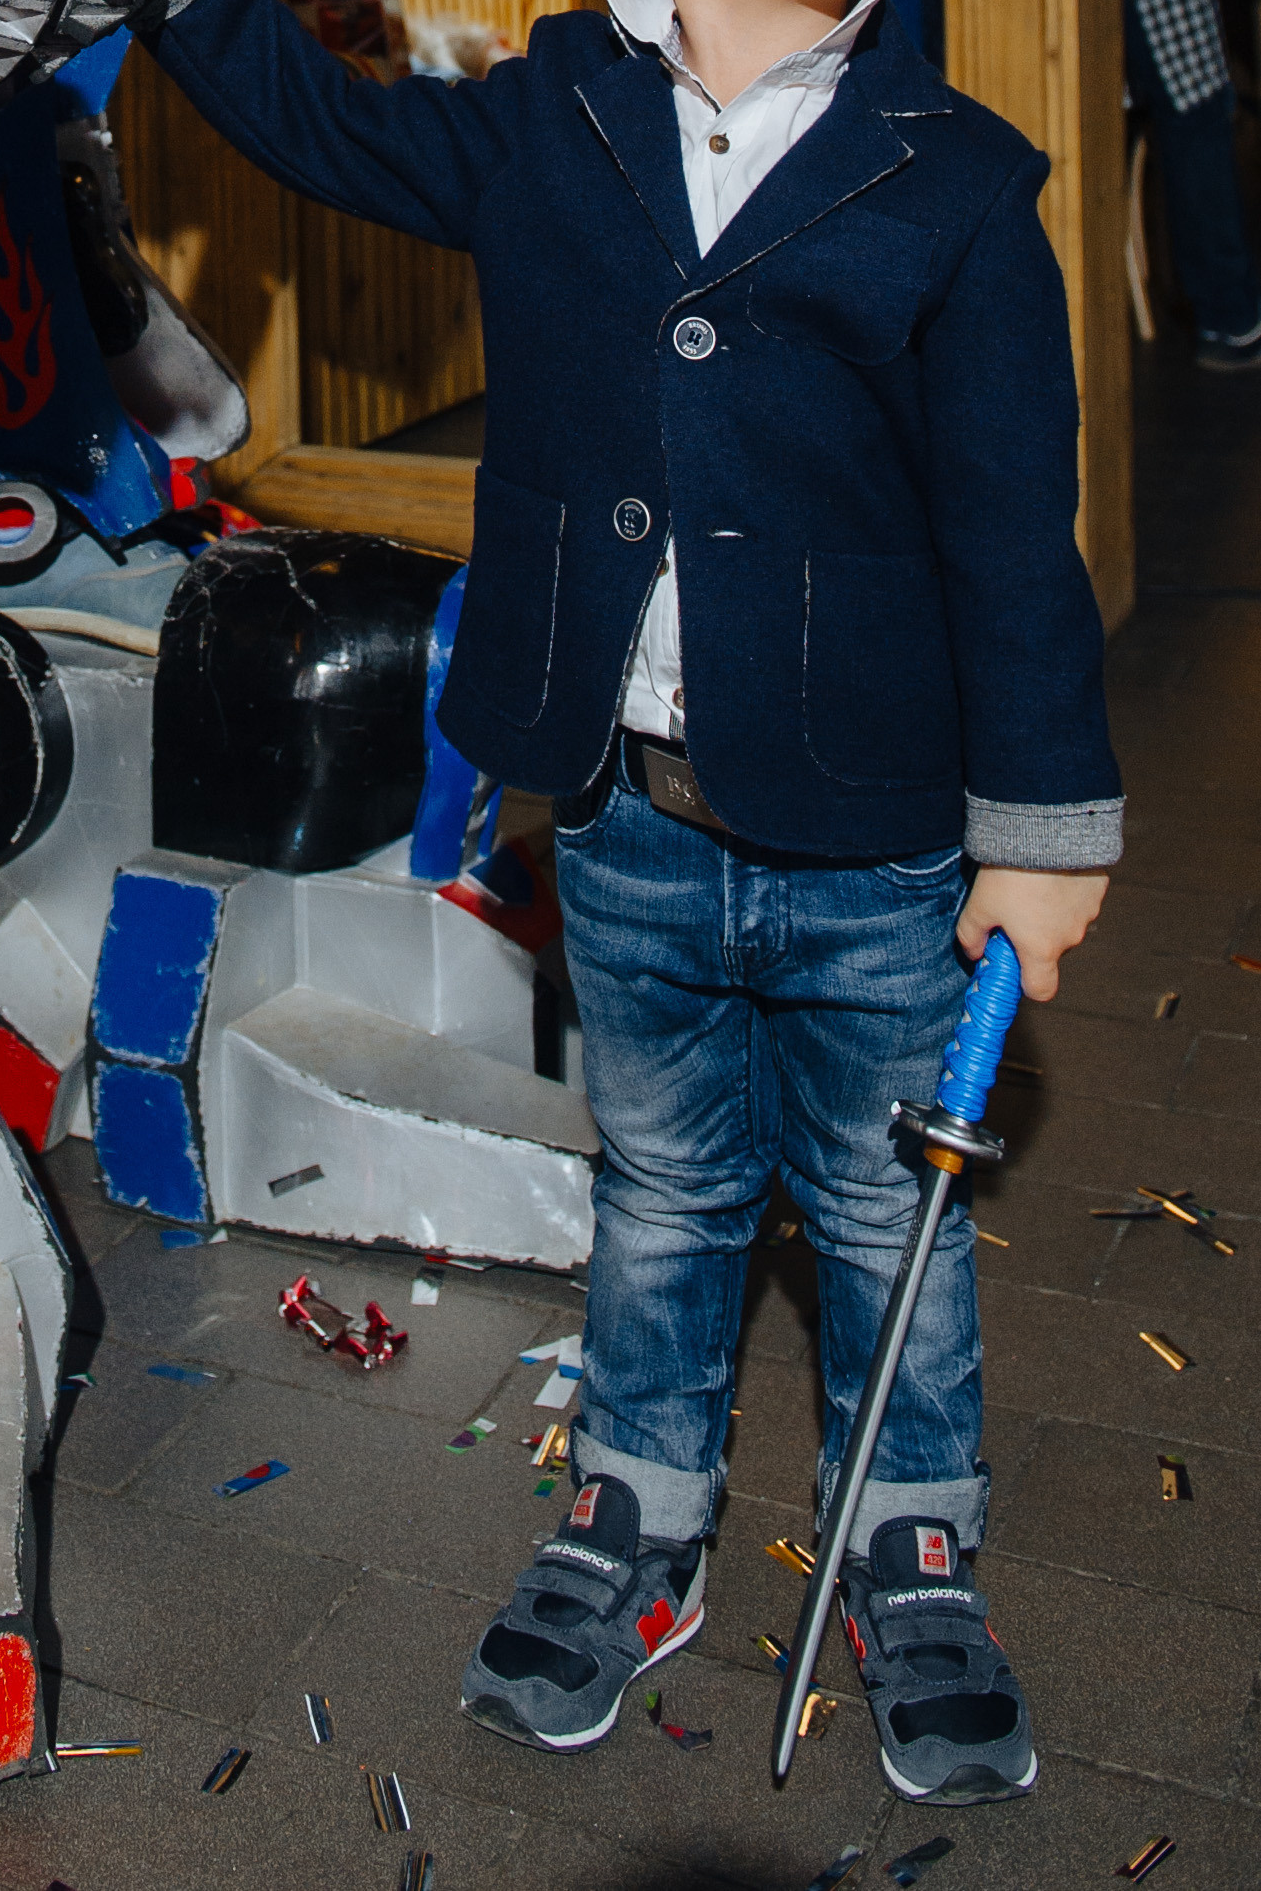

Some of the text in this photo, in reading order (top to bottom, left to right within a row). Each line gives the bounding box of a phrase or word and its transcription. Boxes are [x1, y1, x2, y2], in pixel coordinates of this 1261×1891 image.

[561, 1544, 614, 1571] balance
[887, 1587, 972, 1606] new balance
